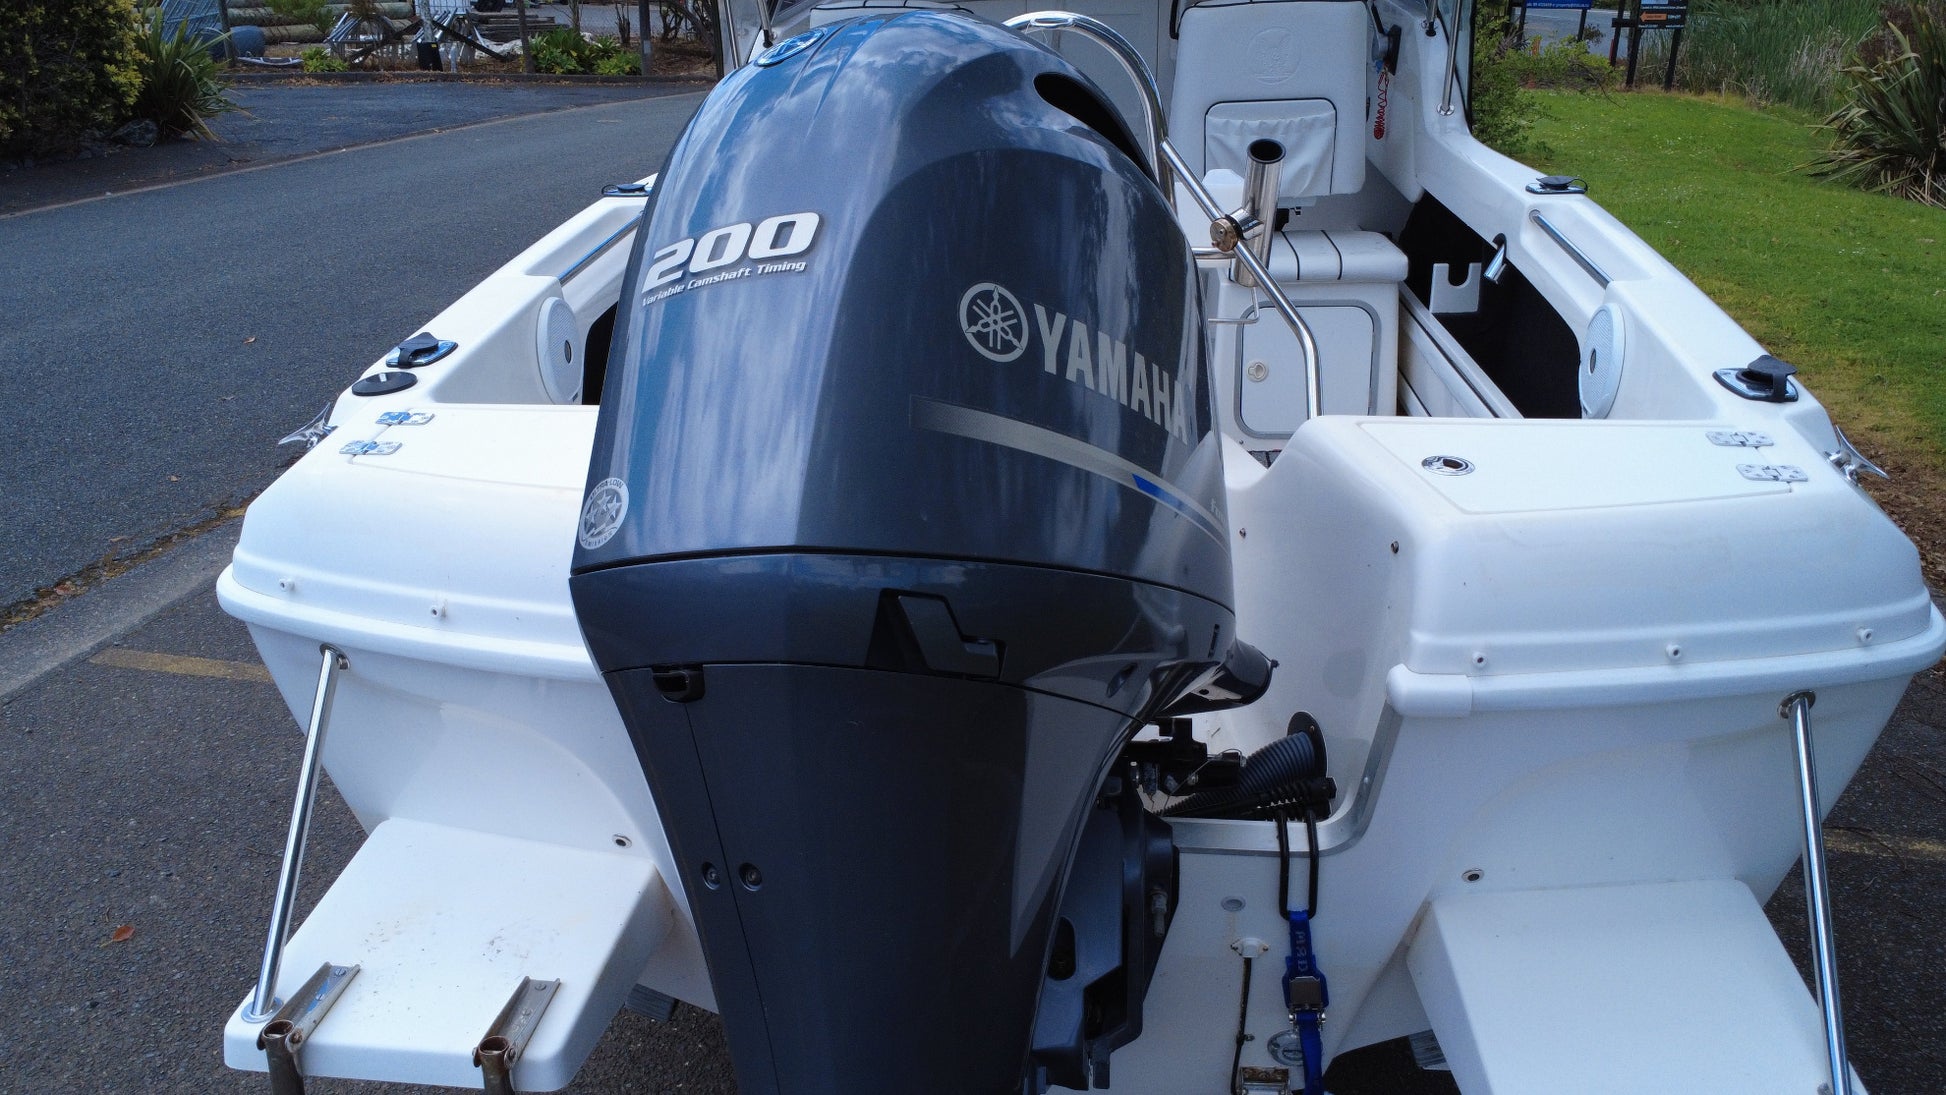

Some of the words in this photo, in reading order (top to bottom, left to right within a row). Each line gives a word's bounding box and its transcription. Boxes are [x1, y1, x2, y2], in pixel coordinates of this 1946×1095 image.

[641, 212, 820, 293] 200
[642, 282, 685, 306] Variable
[687, 266, 752, 290] Camshaft
[757, 259, 807, 276] Timing
[1034, 303, 1188, 446] YAMAHA
